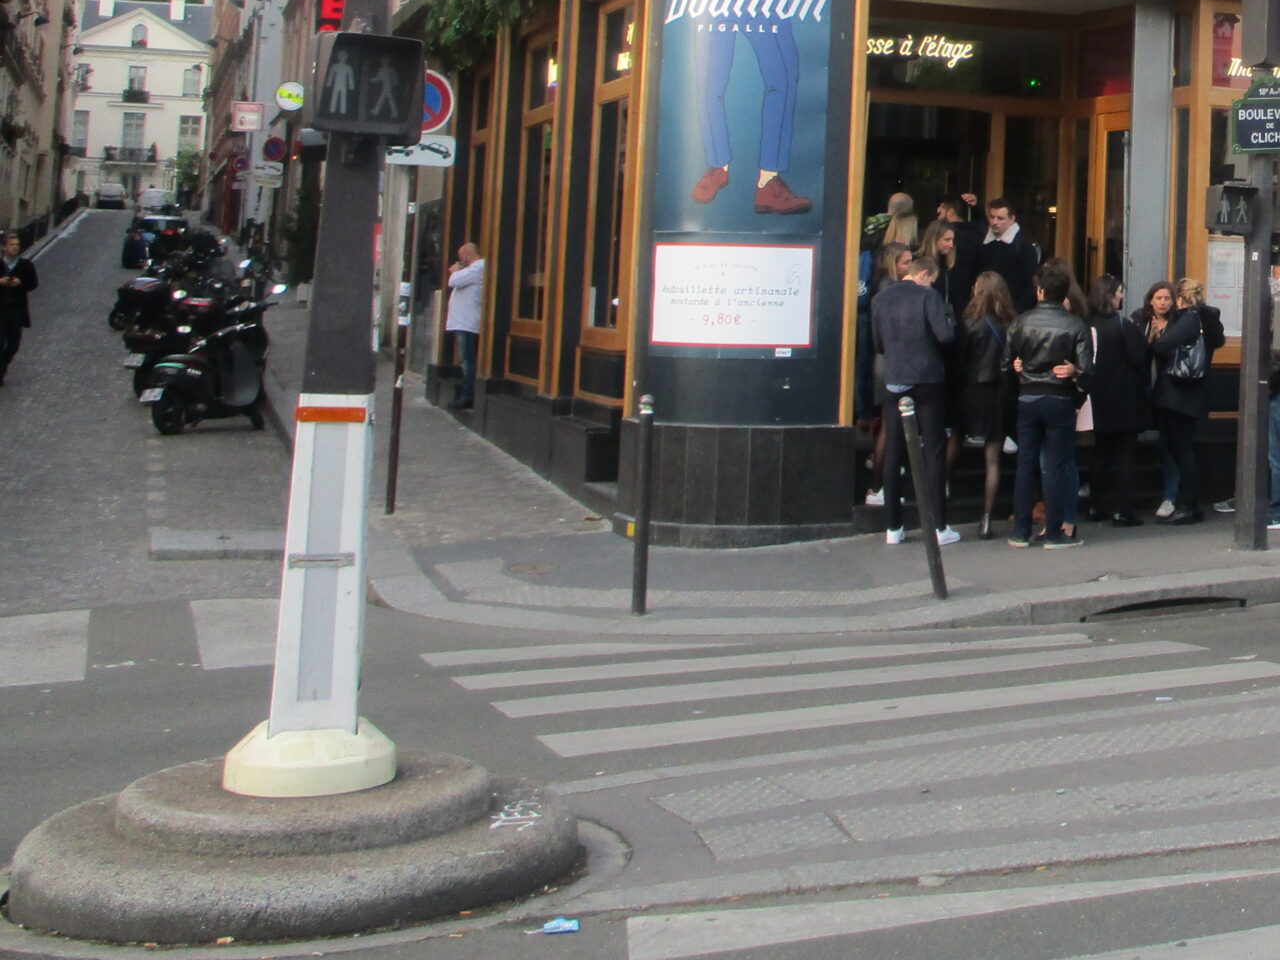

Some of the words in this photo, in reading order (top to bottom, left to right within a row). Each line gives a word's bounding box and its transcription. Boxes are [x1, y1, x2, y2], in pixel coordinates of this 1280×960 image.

[697, 23, 779, 34] PIGALLE
[866, 38, 894, 55] sse
[899, 34, 913, 56] à
[918, 35, 975, 69] l'étage
